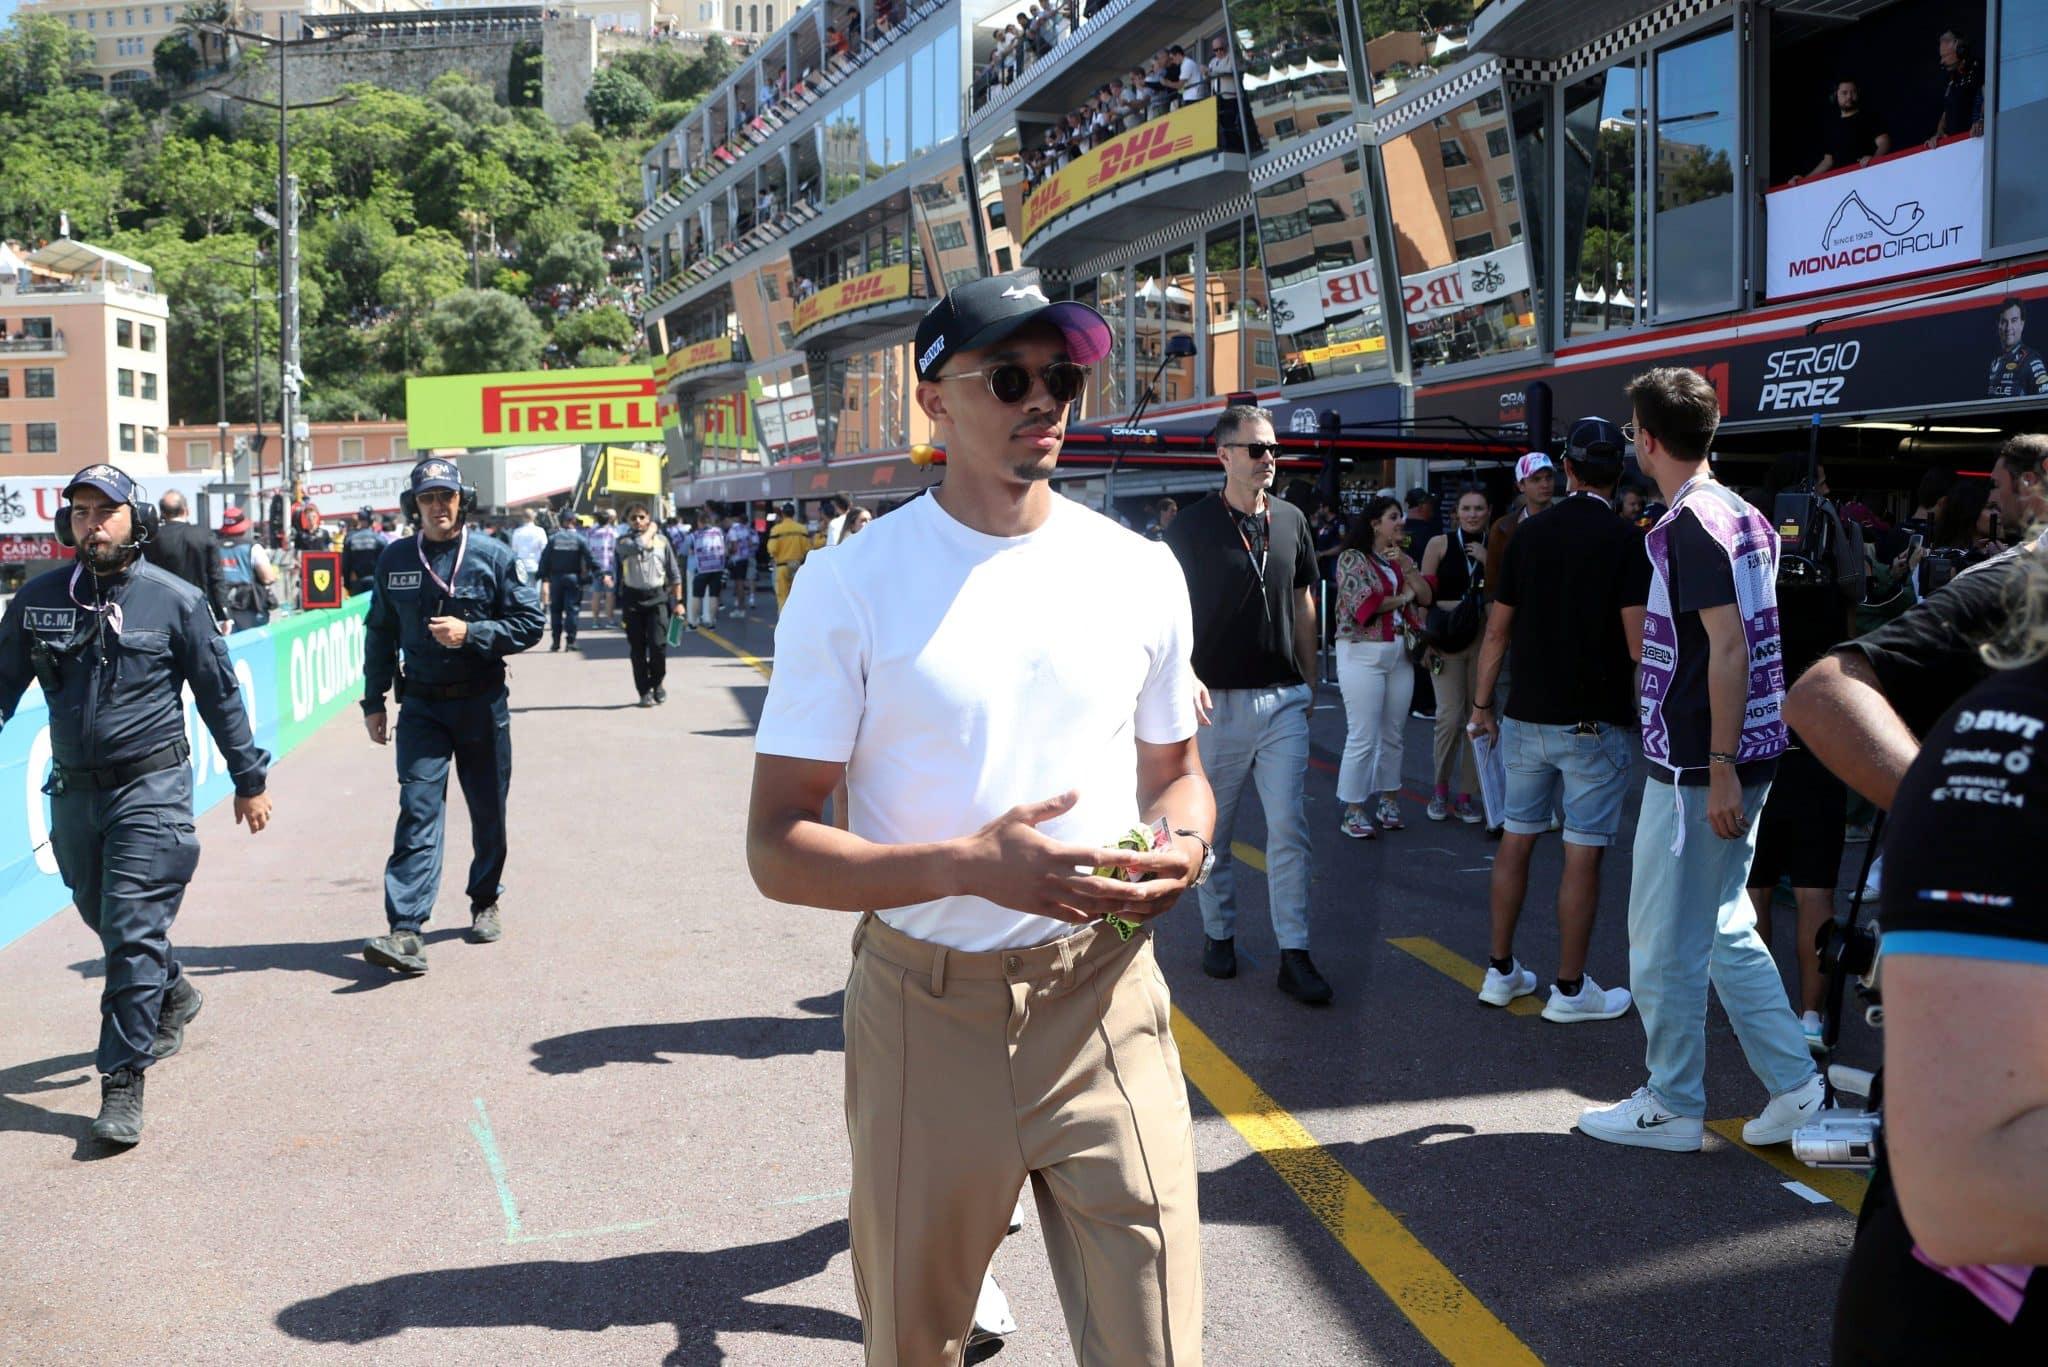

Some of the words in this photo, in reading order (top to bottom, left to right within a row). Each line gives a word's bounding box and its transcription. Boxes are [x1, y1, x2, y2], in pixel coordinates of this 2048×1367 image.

[1099, 122, 1174, 183] DHL
[1030, 177, 1062, 227] DHL
[1833, 237, 1854, 246] SINCE
[1855, 231, 1873, 241] 1929
[841, 274, 884, 306] DHL
[924, 334, 945, 367] BWT
[1763, 340, 1861, 379] SERGIO
[1758, 376, 1845, 412] PEREZ
[1112, 428, 1158, 436] ORACLE
[2, 543, 52, 555] CASINO
[392, 575, 419, 586] A.C.M.
[27, 612, 72, 627] A.C.M.
[290, 612, 366, 722] aramco
[1974, 710, 2044, 740] BWT
